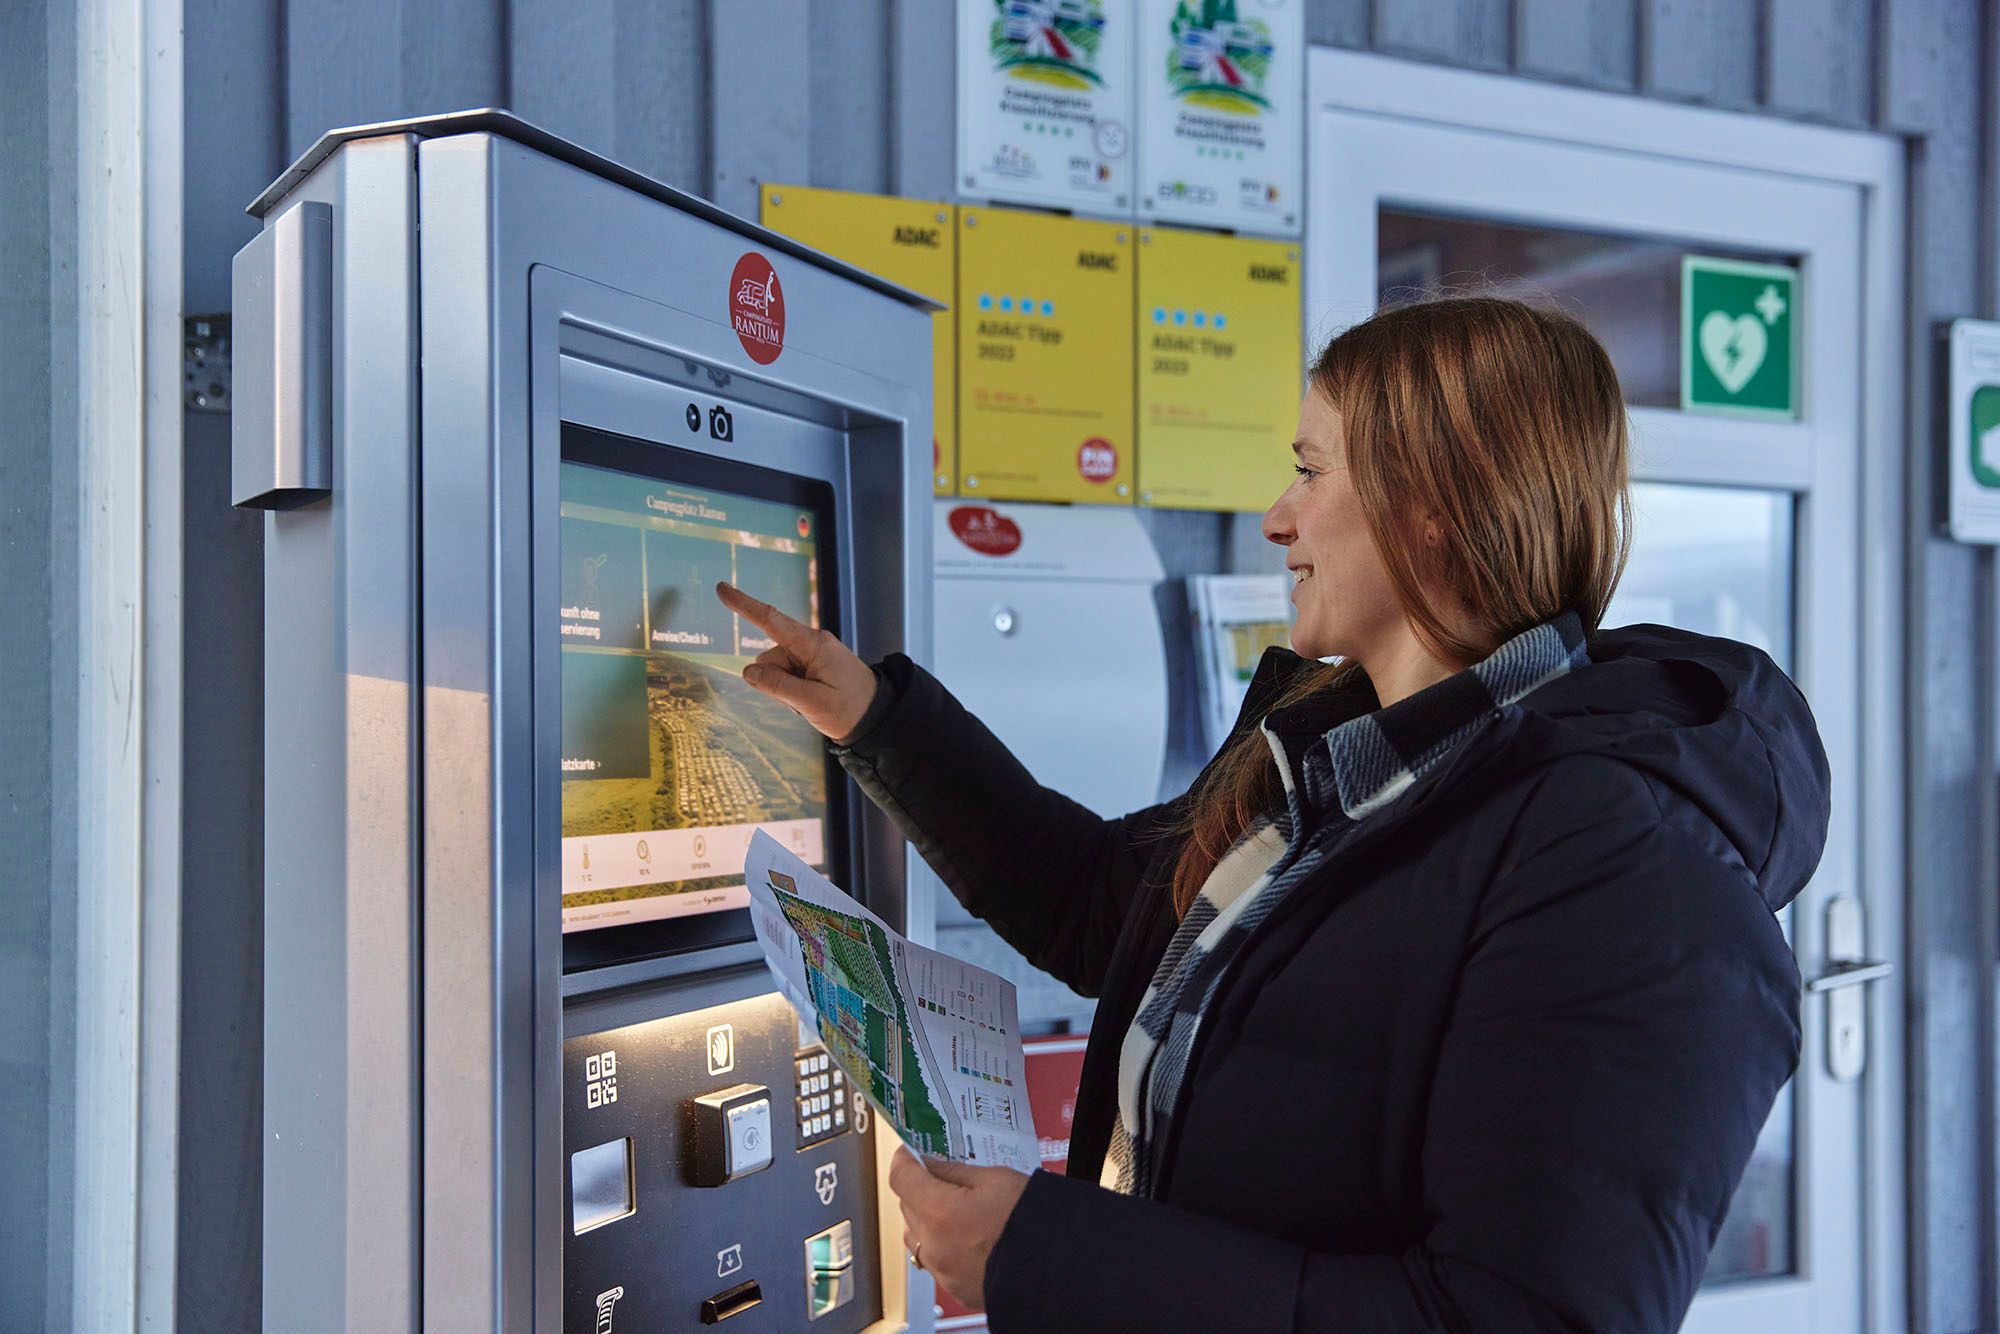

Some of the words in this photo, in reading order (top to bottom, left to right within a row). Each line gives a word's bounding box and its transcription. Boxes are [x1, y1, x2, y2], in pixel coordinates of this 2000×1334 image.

[893, 226, 940, 248] ADAC
[1078, 252, 1118, 272] ADAC
[1248, 264, 1290, 284] ADAC
[735, 315, 779, 344] RANTUM
[978, 319, 1023, 340] ADAC
[1152, 334, 1197, 354] ADAC
[580, 607, 600, 620] ohne
